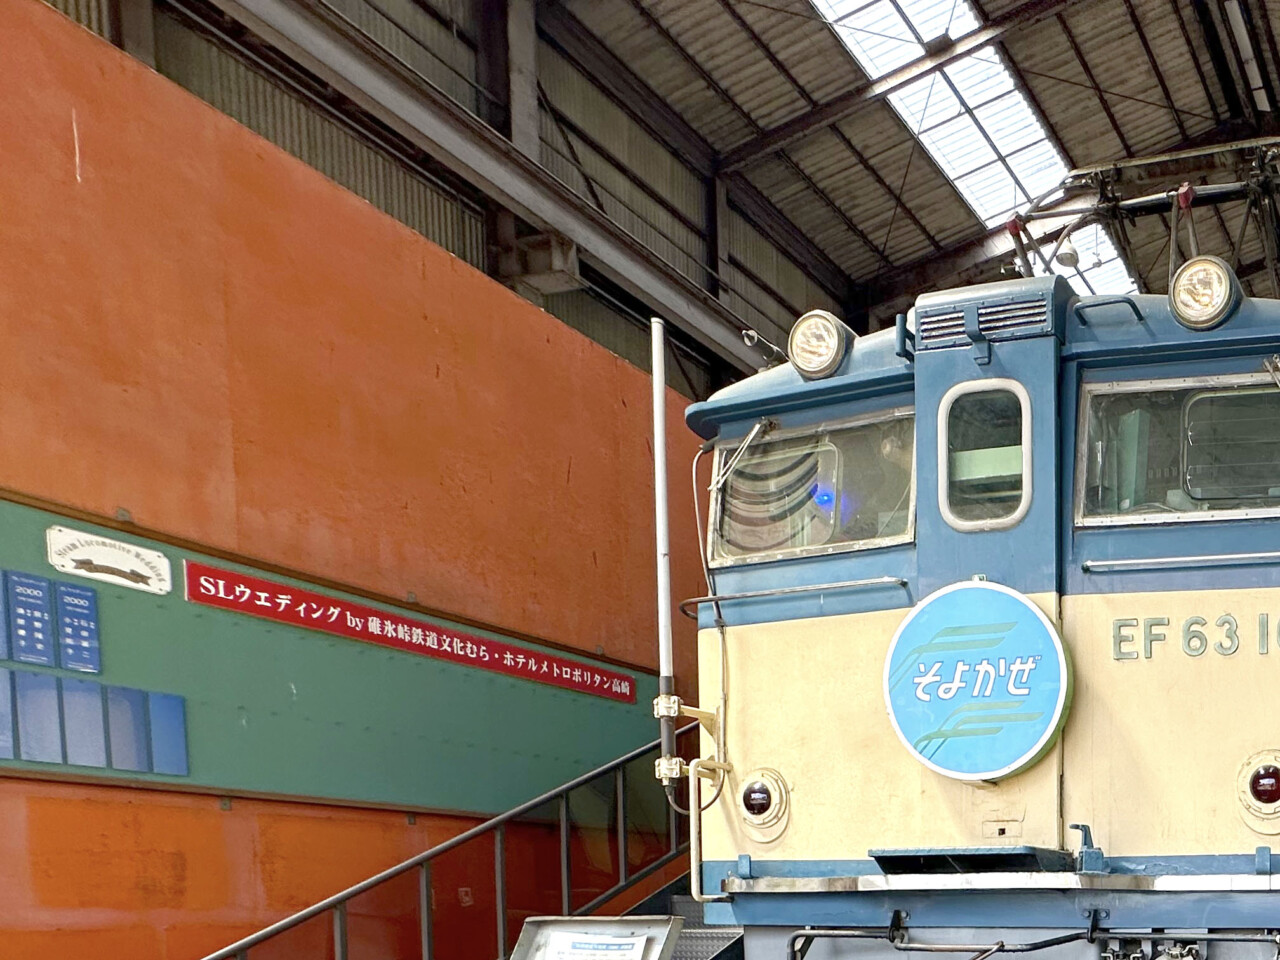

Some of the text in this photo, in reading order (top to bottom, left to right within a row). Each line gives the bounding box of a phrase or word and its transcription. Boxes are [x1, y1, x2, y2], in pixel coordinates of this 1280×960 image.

[78, 538, 132, 555] Locomotive
[134, 551, 166, 583] Wedding
[15, 586, 43, 597] 2000
[63, 595, 89, 607] 2000
[199, 575, 341, 623] SLウエディング
[346, 611, 364, 631] by
[912, 655, 1042, 702] そよかぜ
